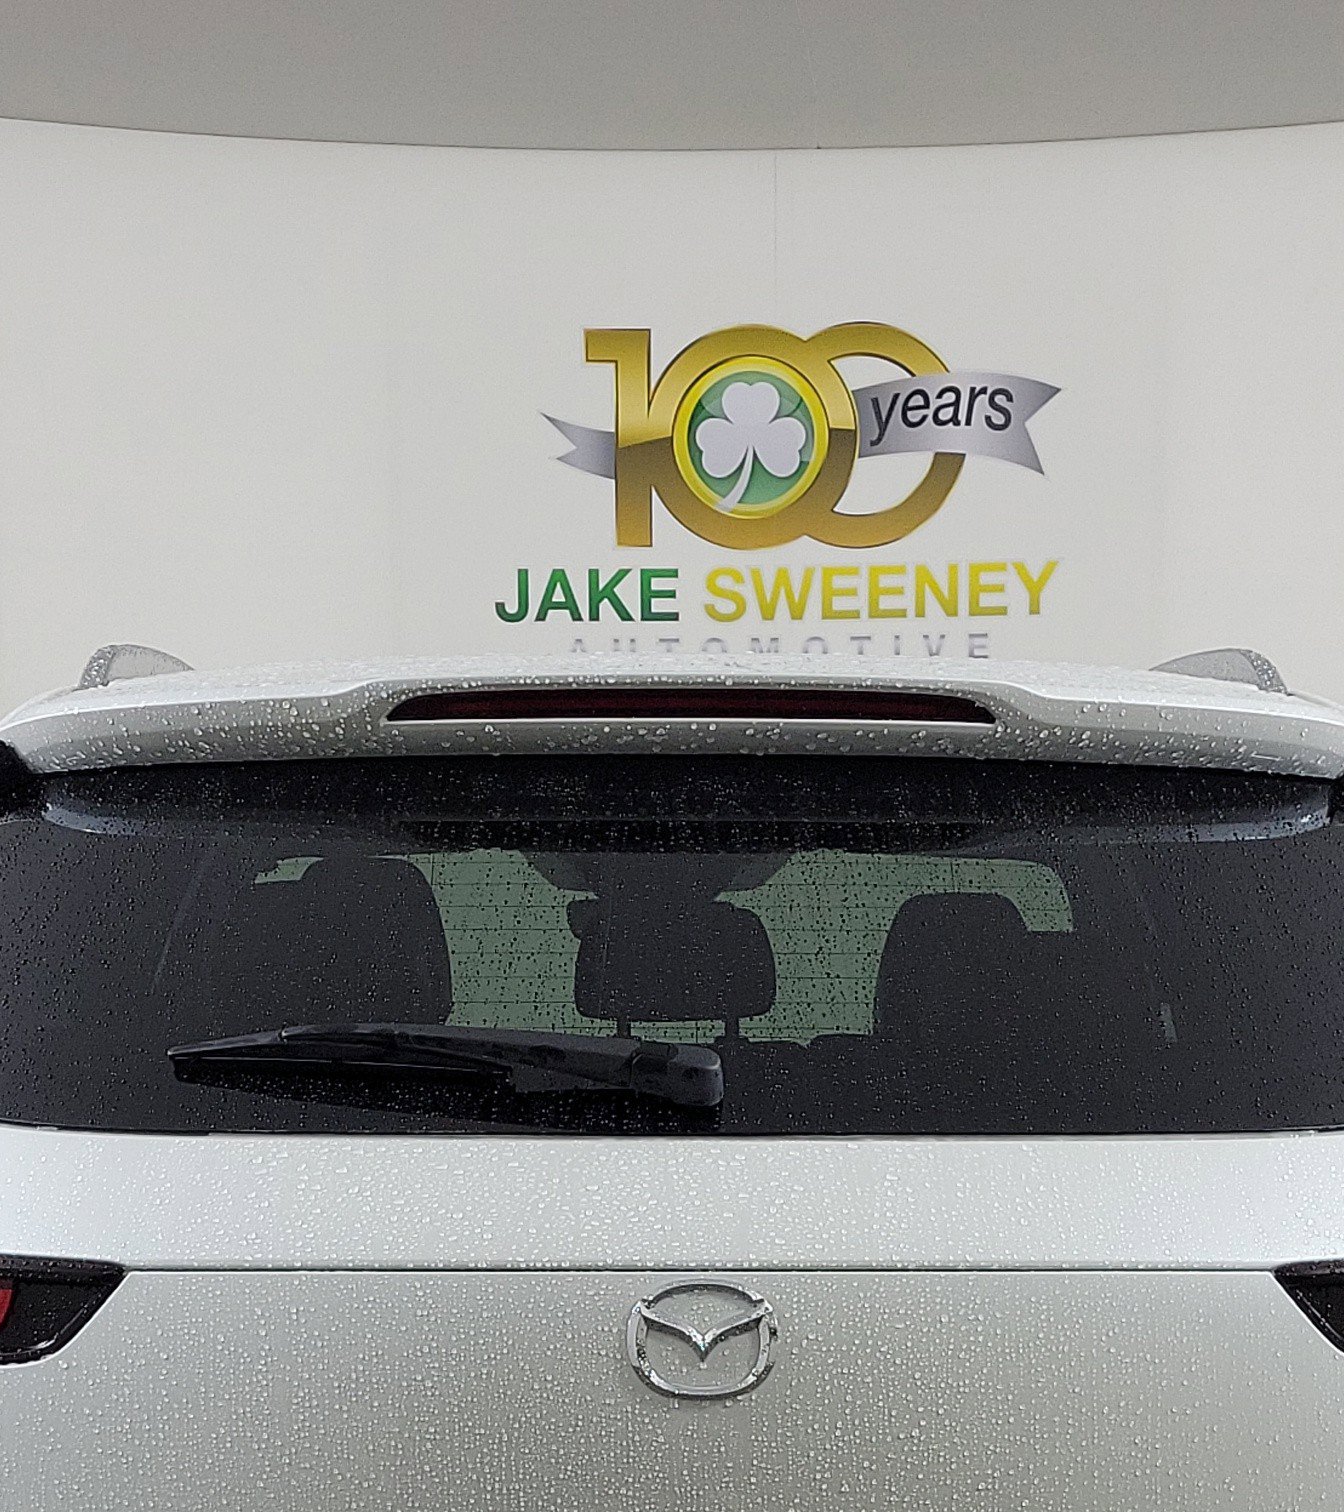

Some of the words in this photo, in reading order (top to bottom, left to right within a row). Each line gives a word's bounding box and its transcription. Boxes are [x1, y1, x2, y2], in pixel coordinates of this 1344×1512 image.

[583, 321, 966, 550] 100
[869, 384, 1015, 446] years
[495, 567, 680, 623] JAKE
[703, 560, 1059, 622] SWEENEY
